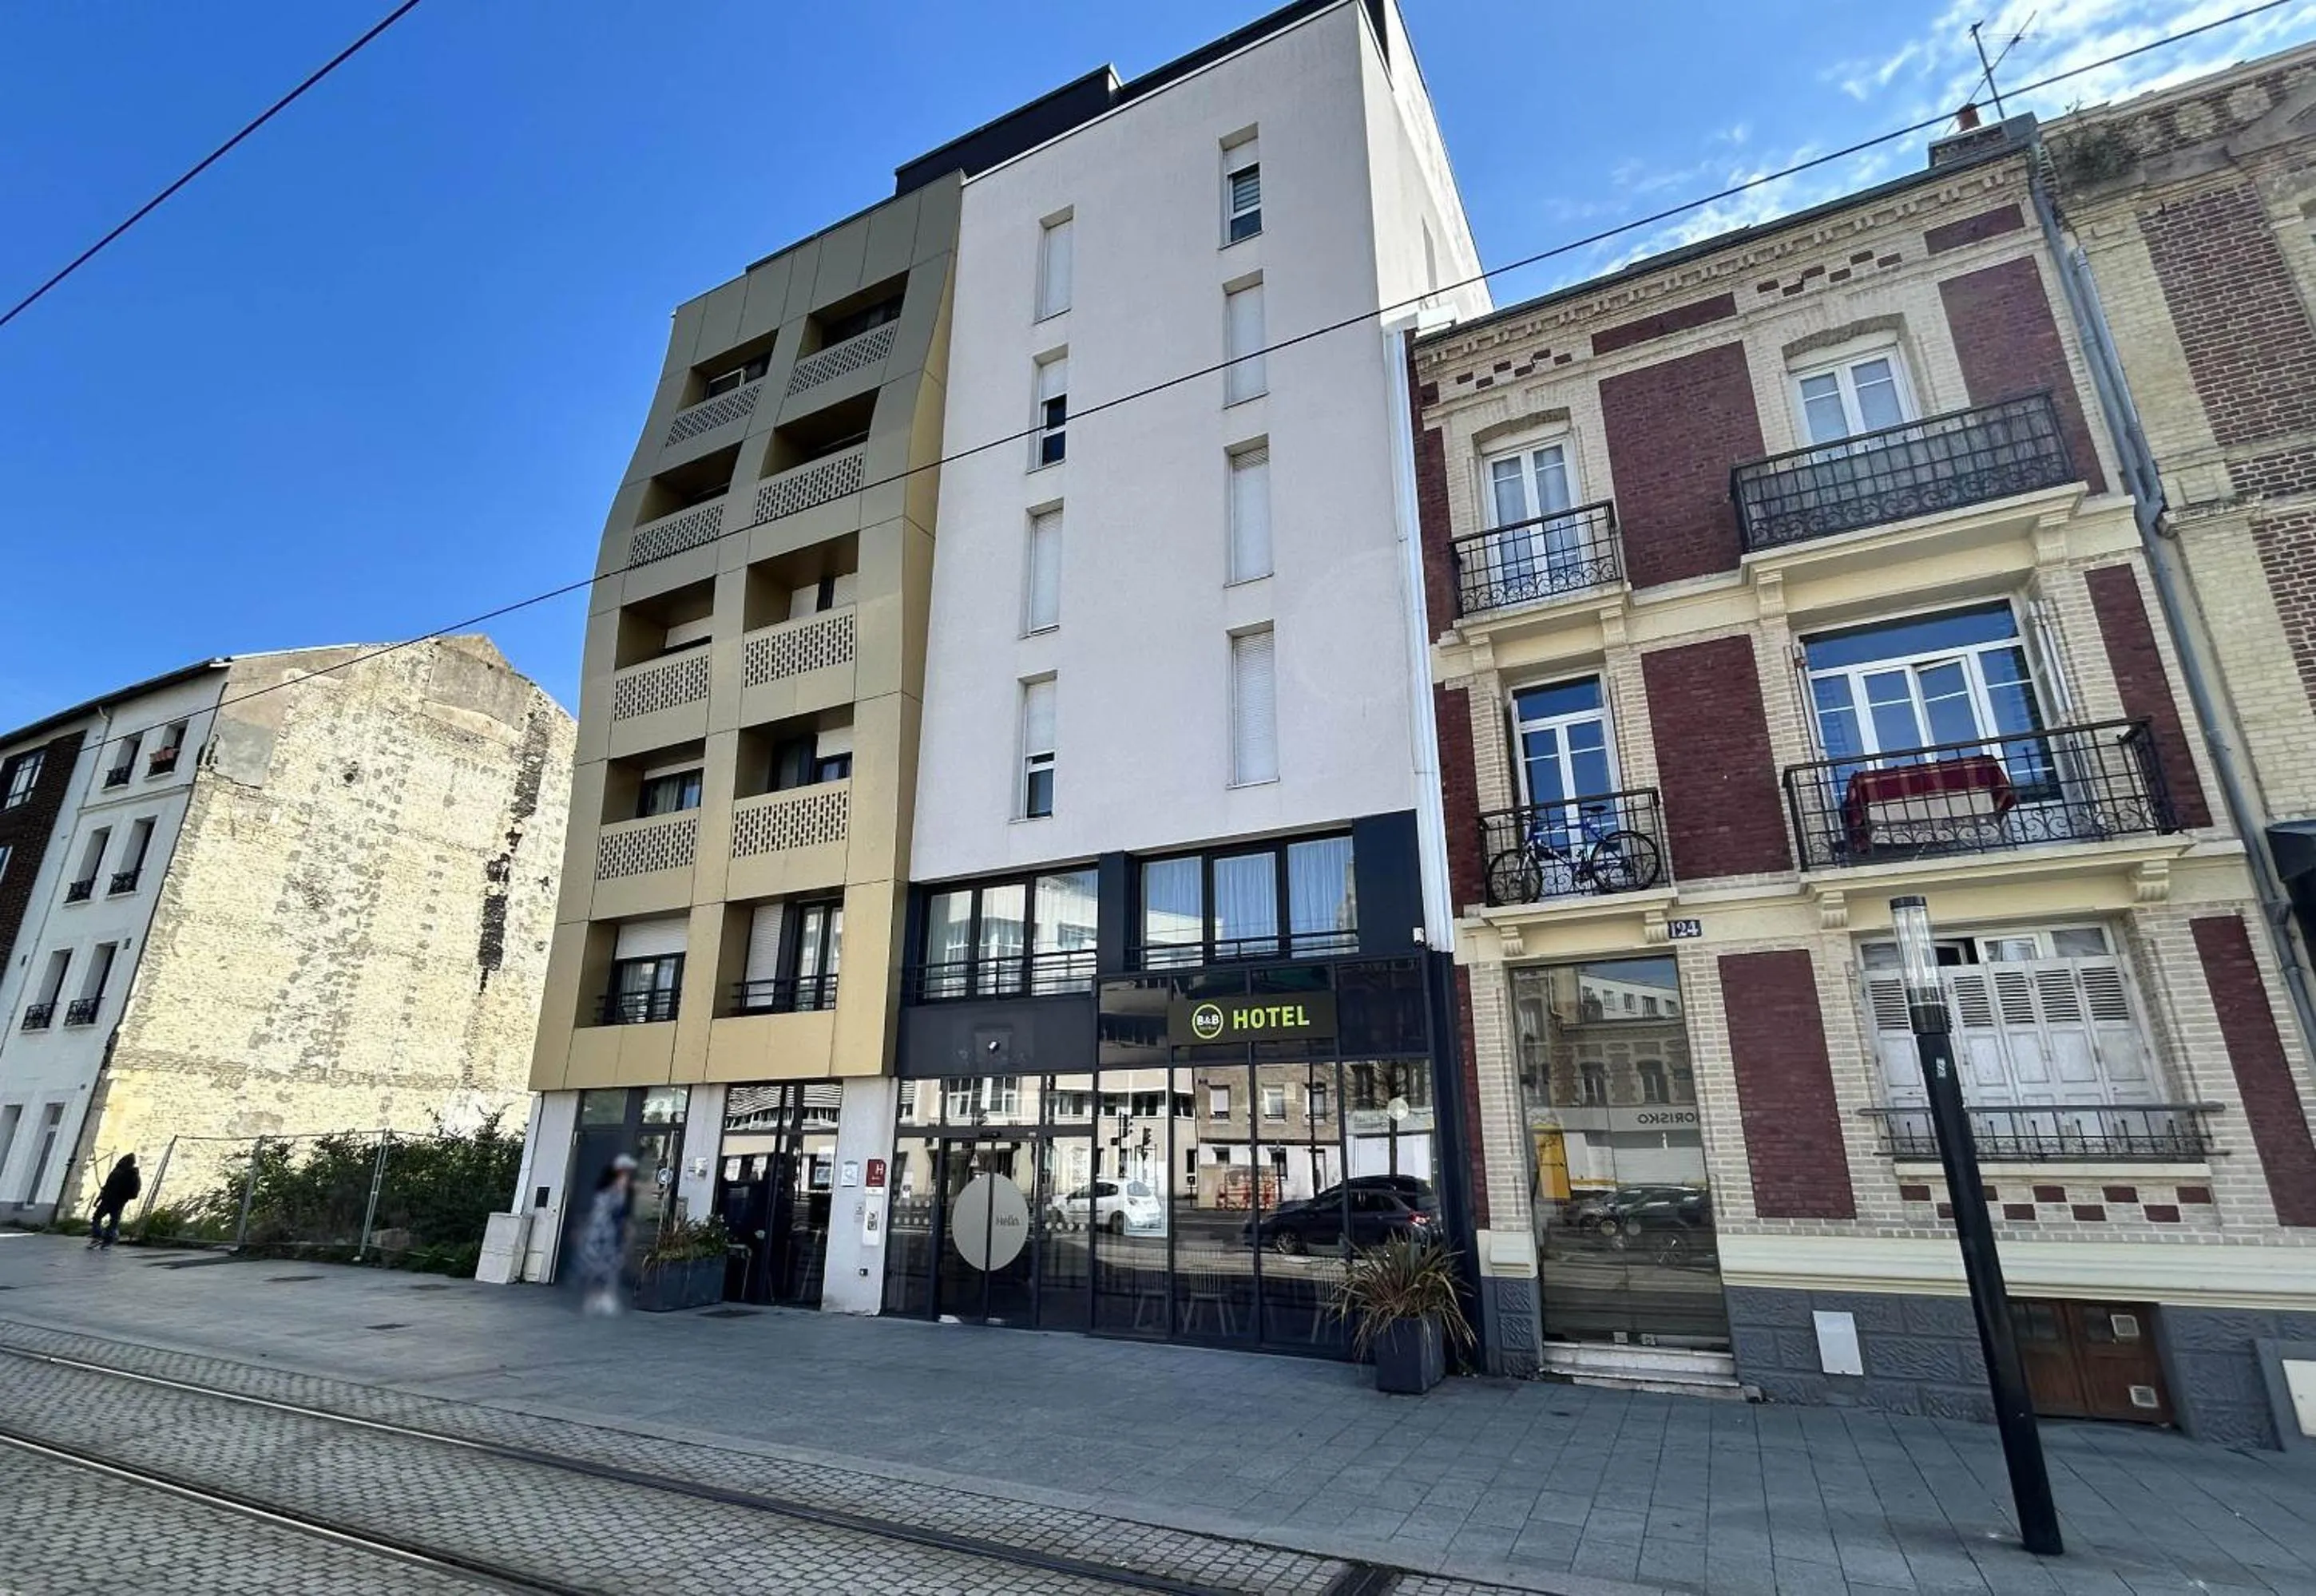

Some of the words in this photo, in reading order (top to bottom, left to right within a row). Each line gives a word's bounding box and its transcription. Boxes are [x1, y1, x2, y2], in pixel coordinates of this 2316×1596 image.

[1670, 921, 1699, 937] 124
[1196, 1014, 1219, 1026] B&B
[1232, 1005, 1310, 1030] HOTEL
